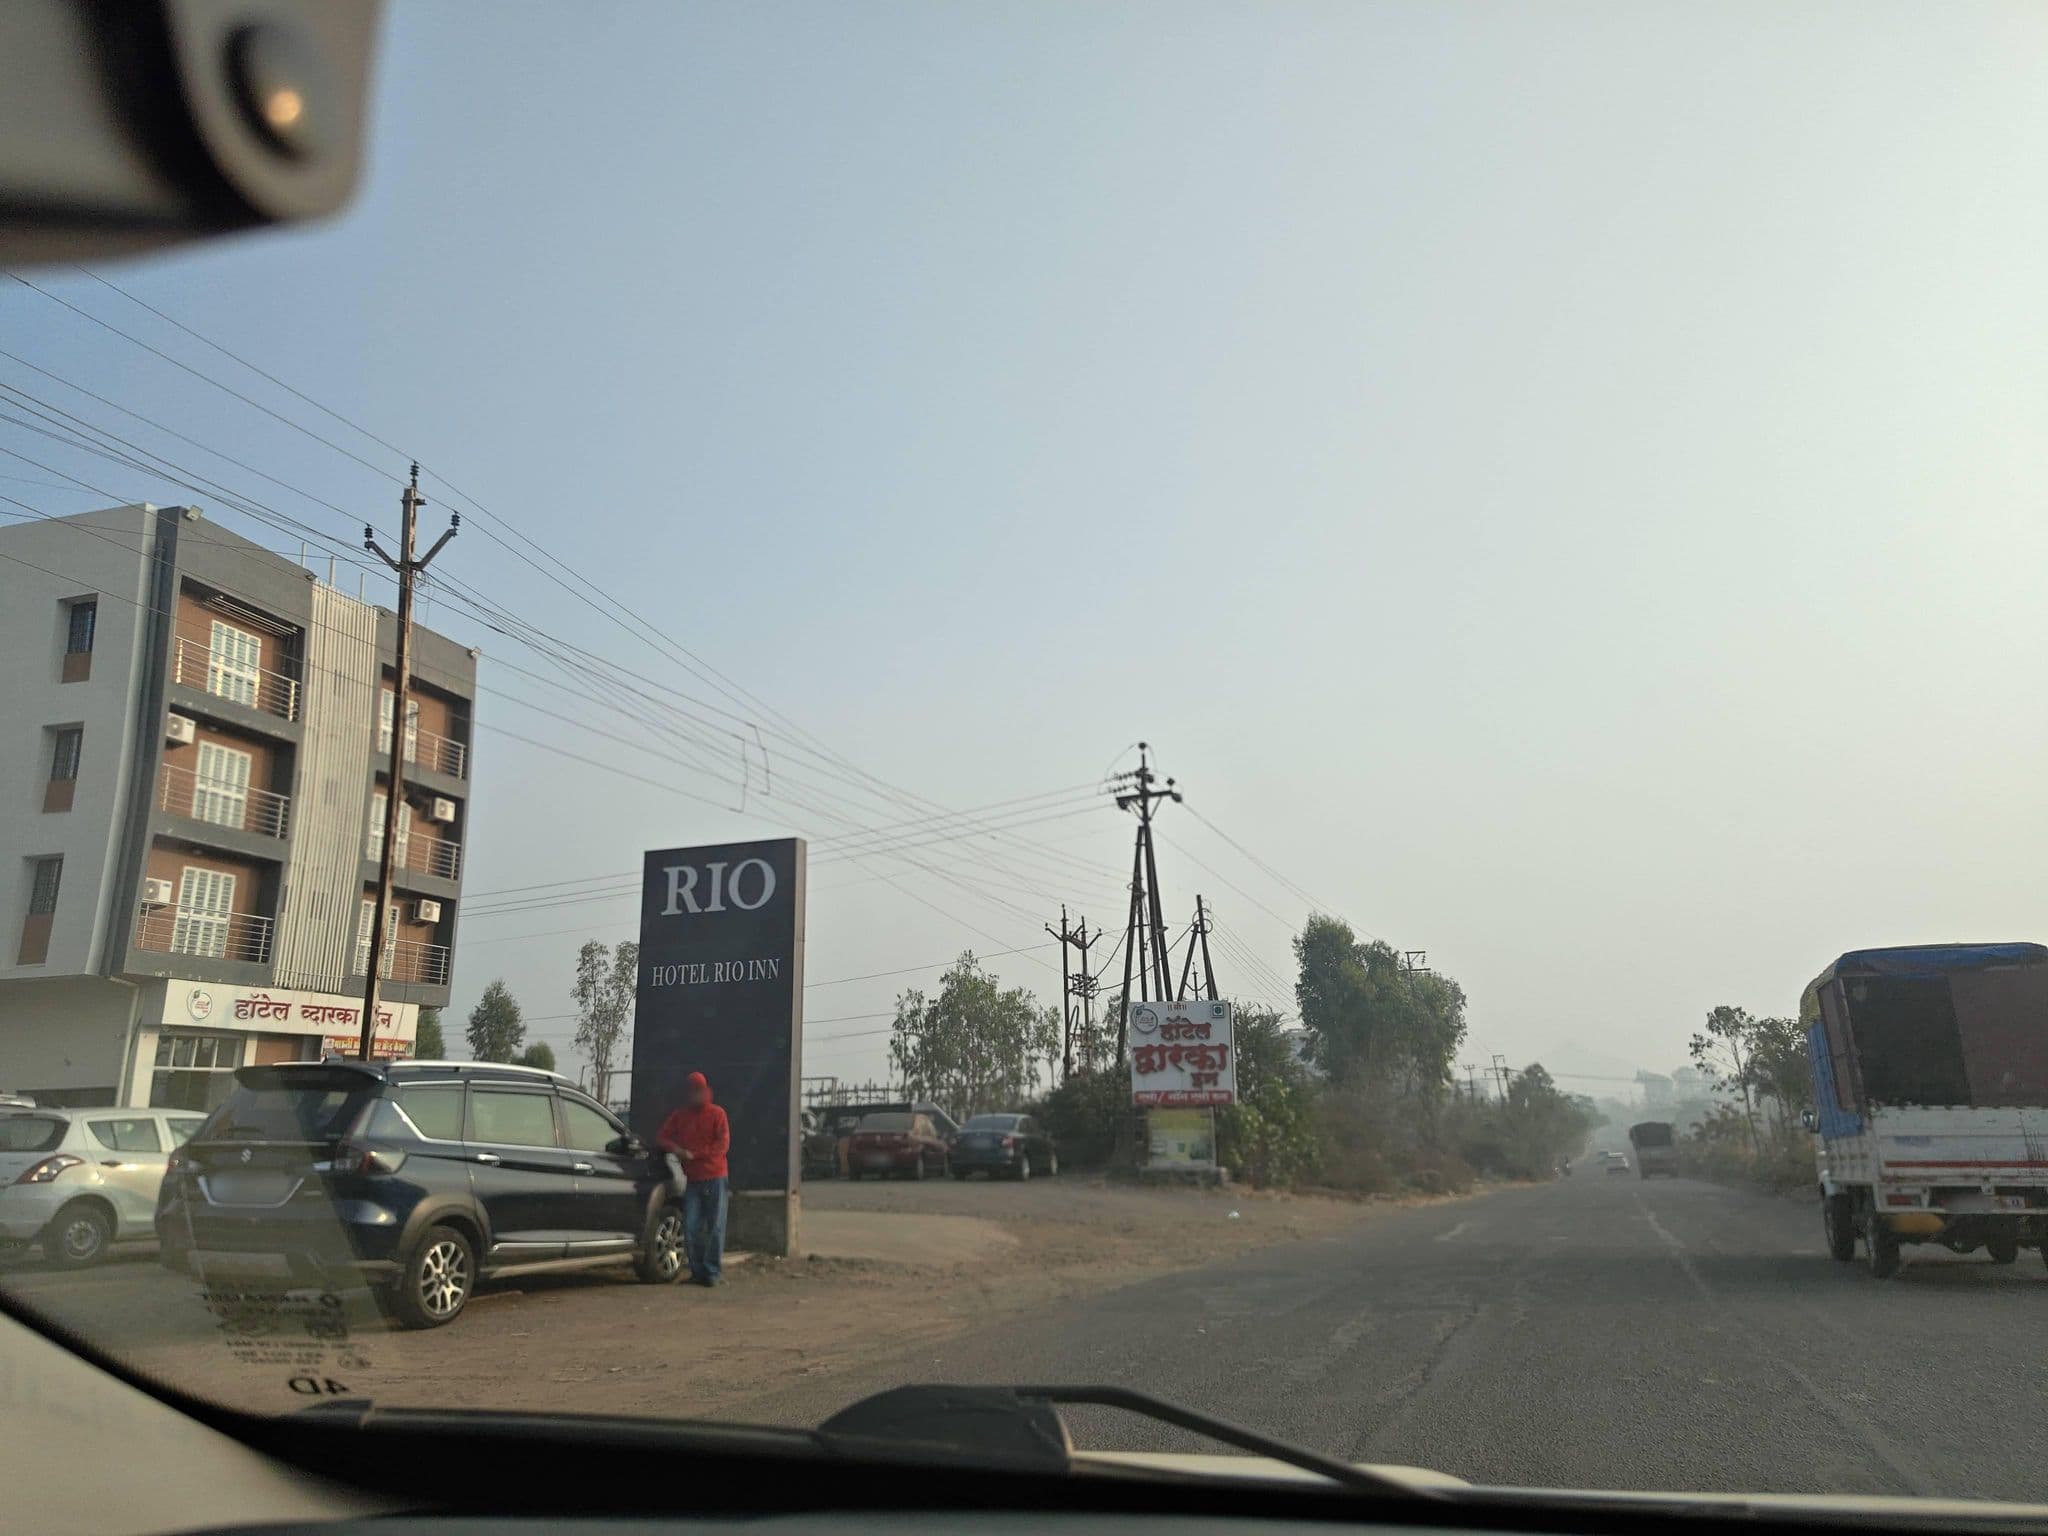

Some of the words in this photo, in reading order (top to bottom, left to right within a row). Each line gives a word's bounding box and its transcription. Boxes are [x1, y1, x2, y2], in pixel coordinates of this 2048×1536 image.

[660, 858, 776, 916] RIO
[652, 963, 709, 987] HOTEL
[714, 960, 744, 983] RIO
[748, 958, 780, 981] INN
[235, 994, 292, 1022] हॉटेल
